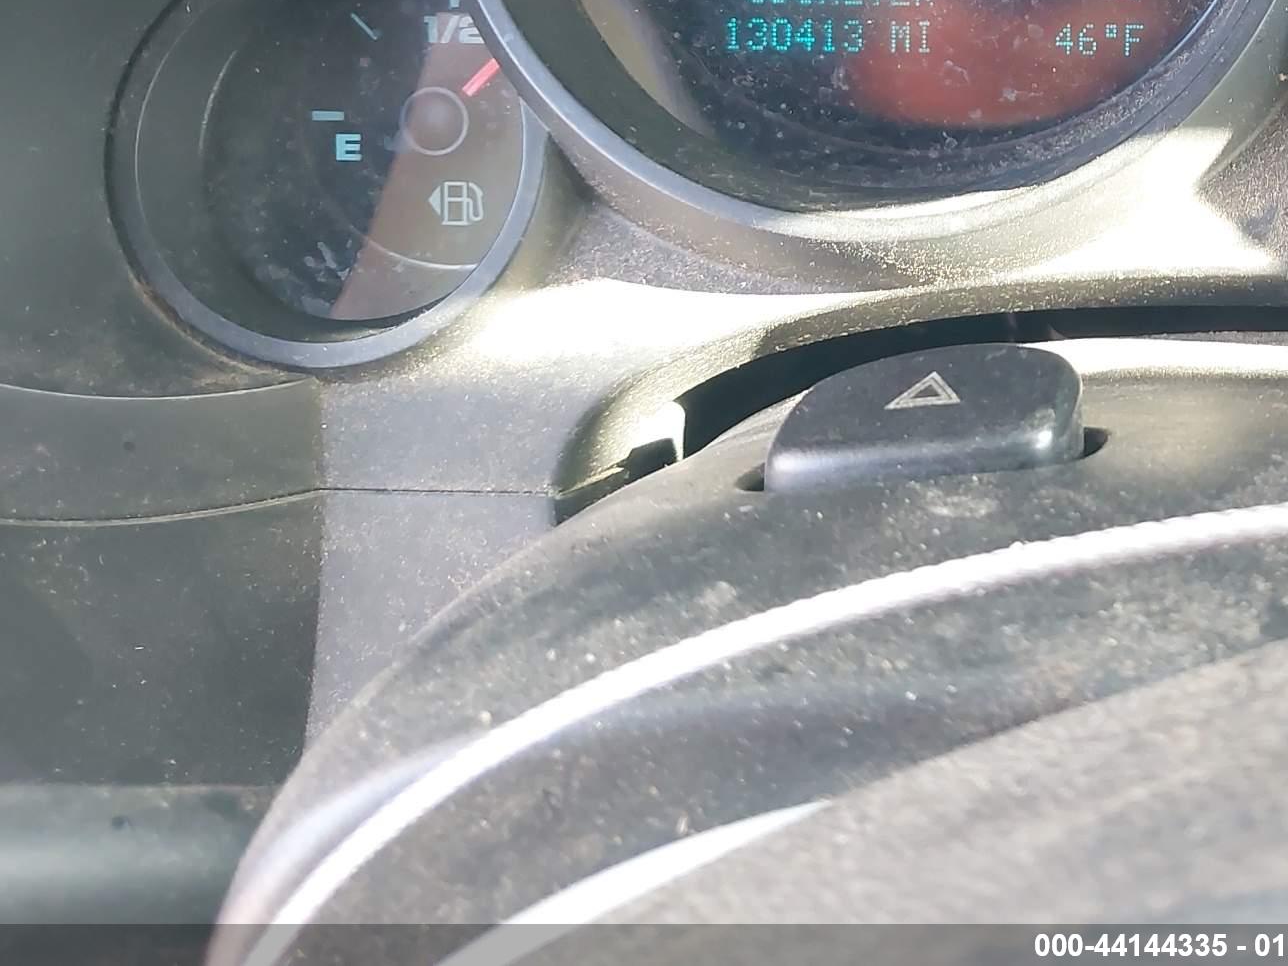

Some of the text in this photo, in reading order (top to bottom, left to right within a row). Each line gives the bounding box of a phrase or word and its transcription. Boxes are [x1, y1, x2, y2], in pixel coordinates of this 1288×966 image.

[424, 15, 485, 44] 1/2
[725, 18, 932, 55] 130413 MI
[1055, 22, 1143, 57] 46°F
[335, 133, 362, 162] E
